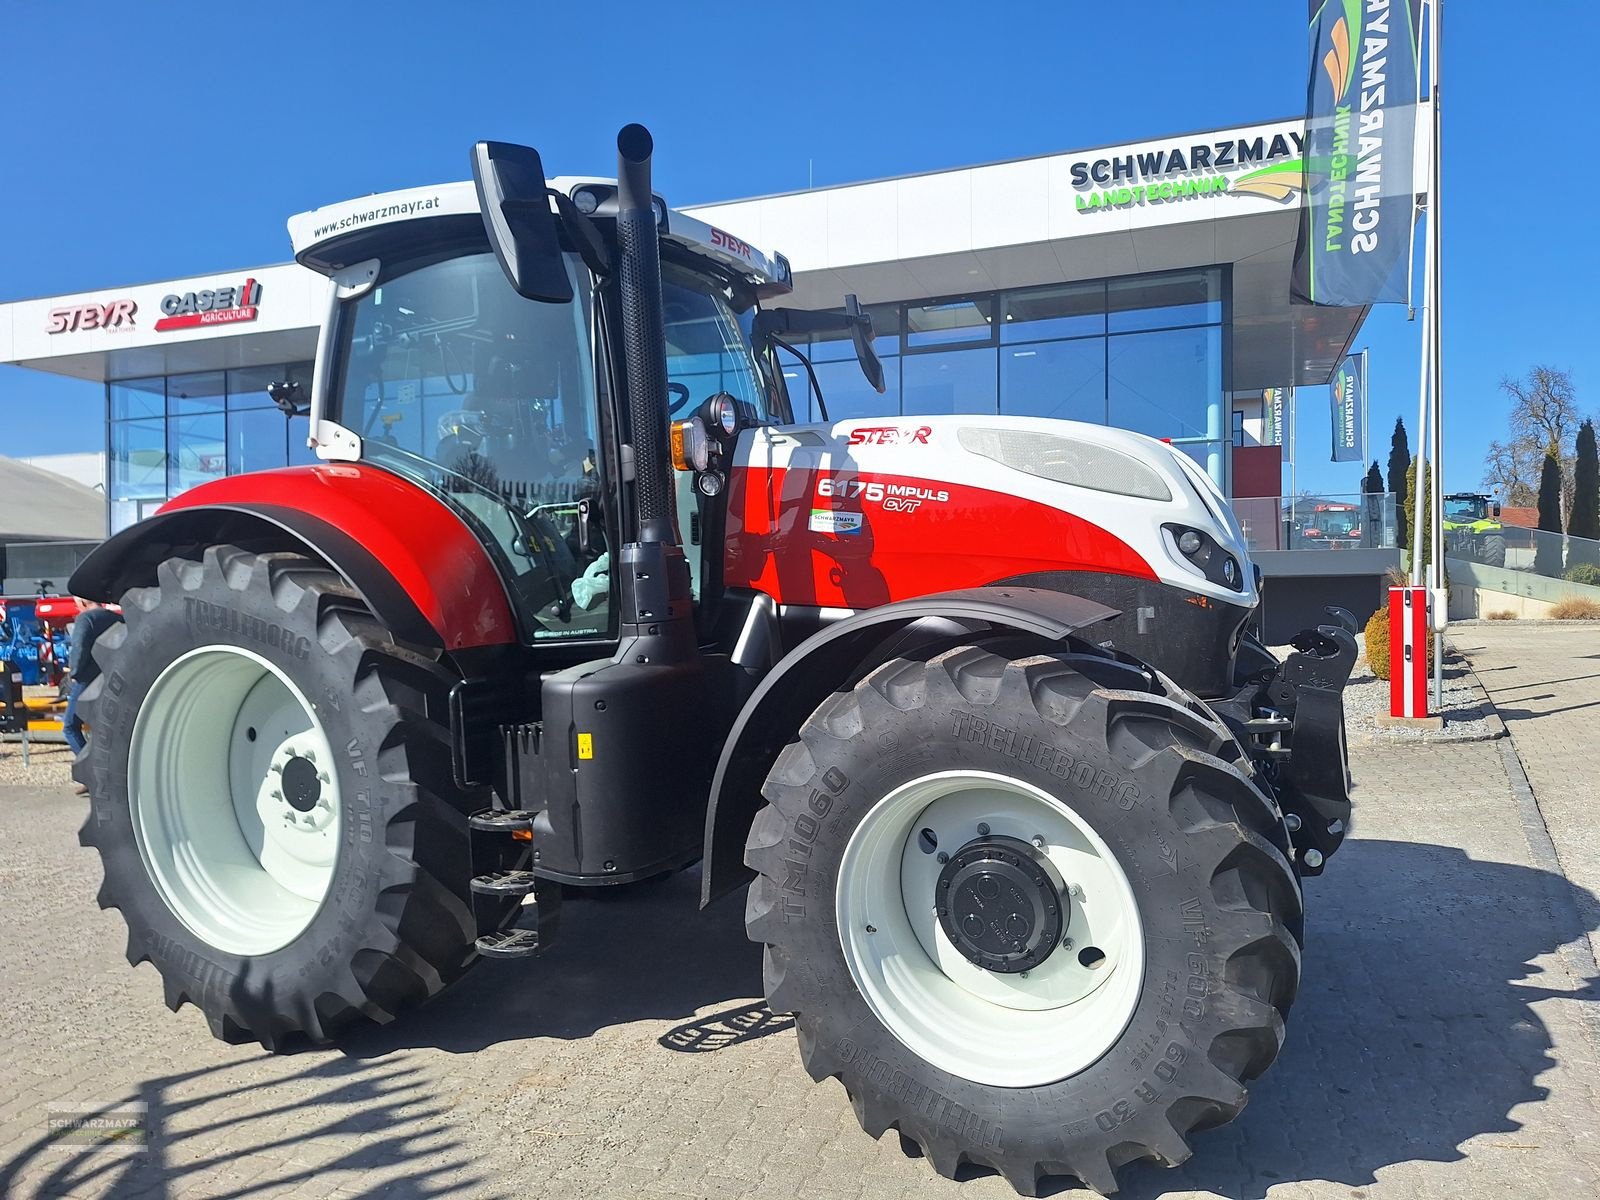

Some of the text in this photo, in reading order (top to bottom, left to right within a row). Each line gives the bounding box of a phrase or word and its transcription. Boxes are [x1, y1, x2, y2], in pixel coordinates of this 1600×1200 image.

[1070, 130, 1310, 187] SCHWARZMAY
[1075, 175, 1229, 212] LANDTECHNIK
[314, 196, 440, 238] www.schwarzmayr.at
[711, 228, 751, 260] STEYR
[46, 299, 138, 334] STEYR
[160, 287, 235, 316] CASE
[200, 309, 252, 323] AGRICULTURE
[846, 426, 932, 445] STEYR
[818, 478, 949, 502] 6175 IMPULS
[882, 498, 922, 513] CVT
[949, 708, 1141, 811] TRELLEBORG
[781, 765, 851, 924] TM1060
[839, 1037, 1006, 1155] TRELLEBORG
[1095, 1098, 1137, 1132] 30
